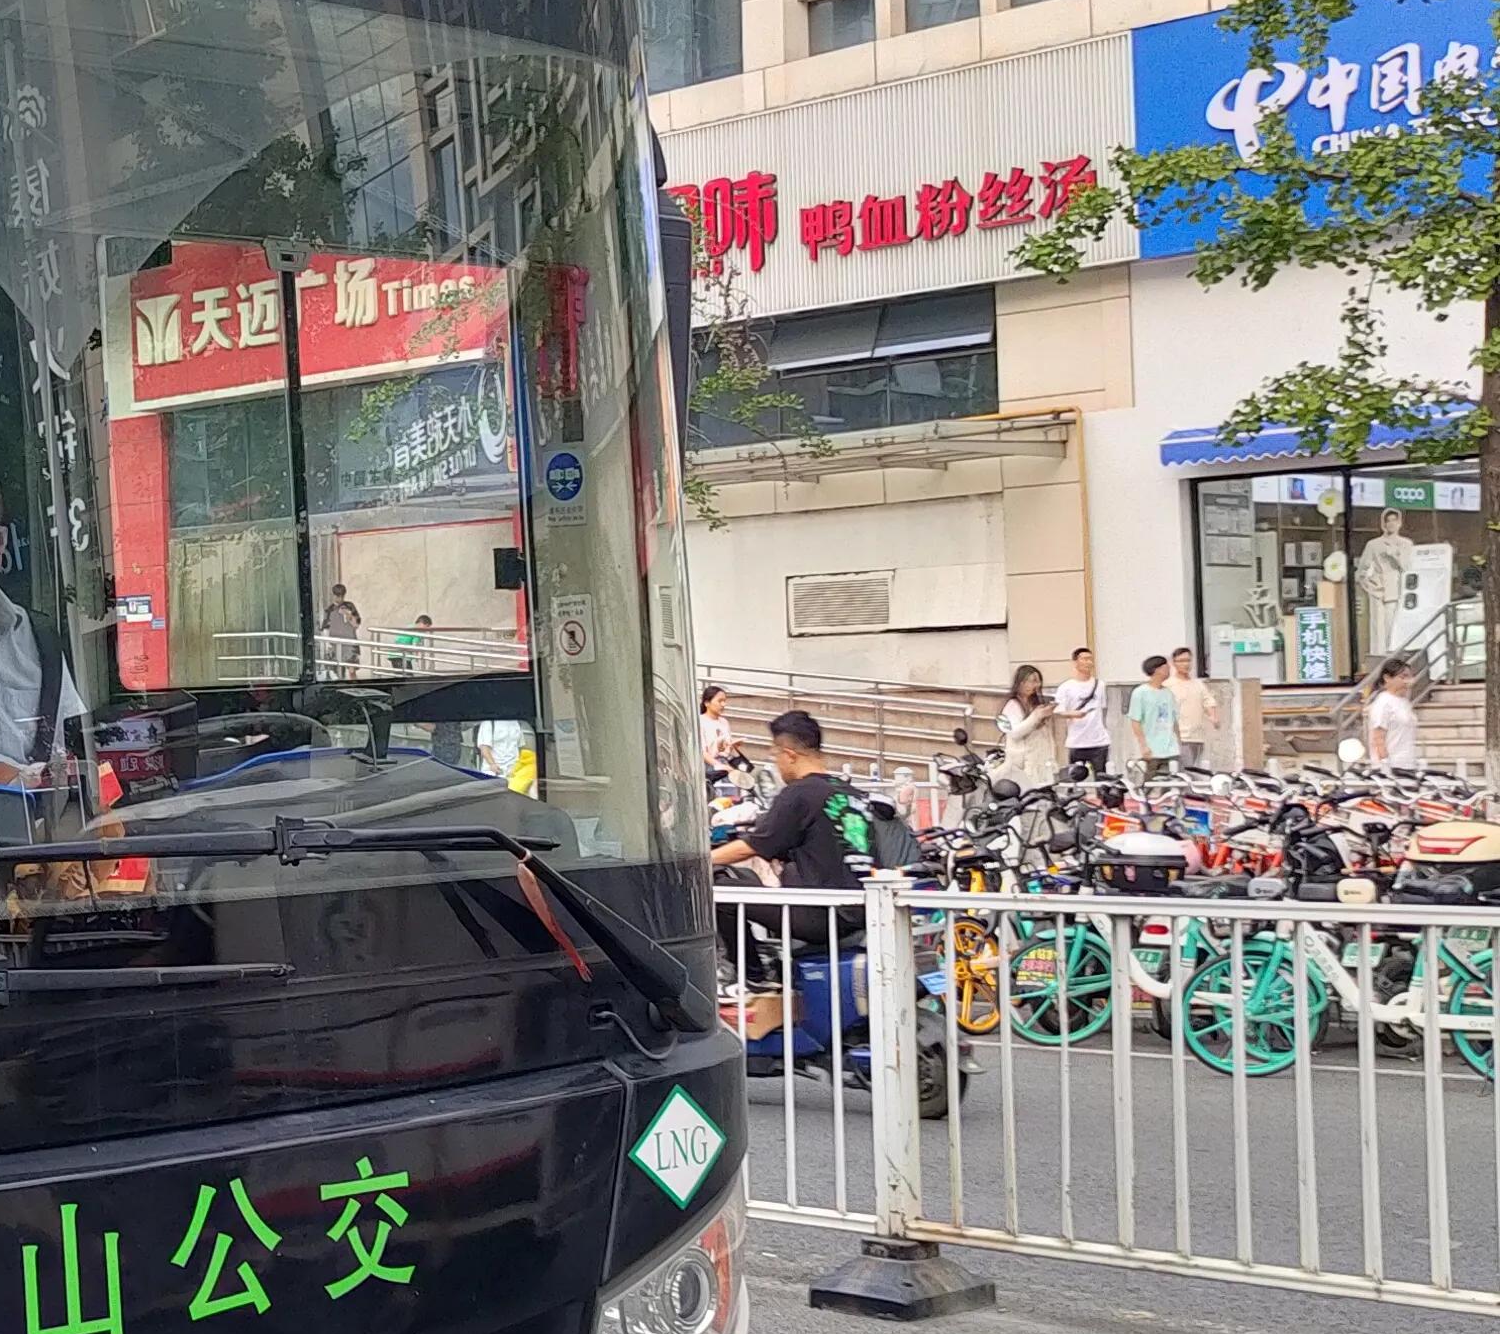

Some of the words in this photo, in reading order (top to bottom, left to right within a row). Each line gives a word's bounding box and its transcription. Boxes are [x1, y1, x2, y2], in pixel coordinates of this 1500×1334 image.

[1307, 41, 1500, 132] 中国电
[667, 170, 778, 273] 味
[799, 154, 1098, 264] 鸭血粉丝汤
[655, 1125, 711, 1172] LNG
